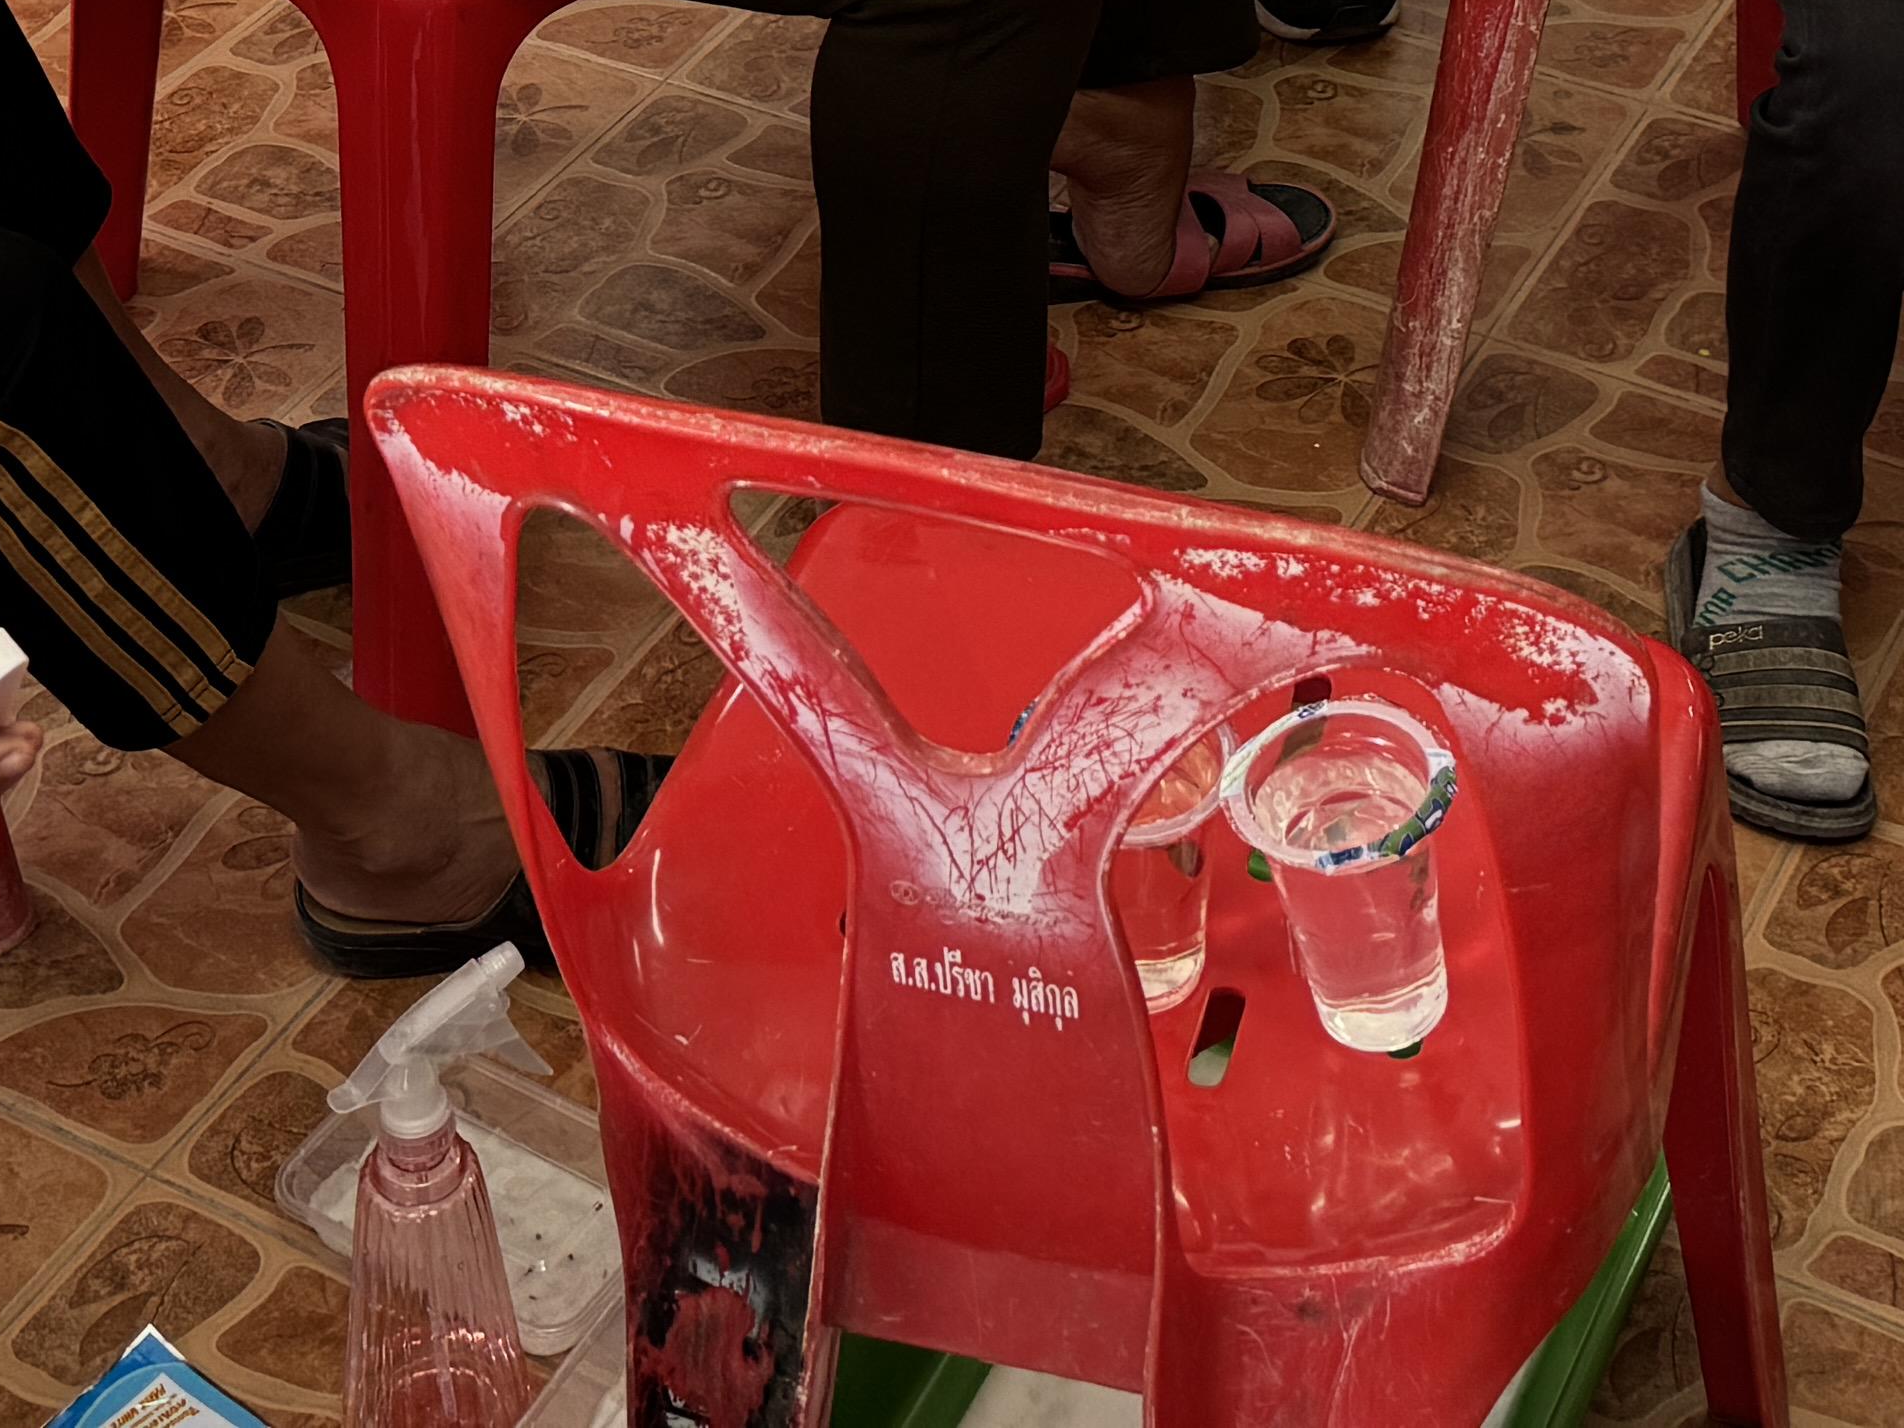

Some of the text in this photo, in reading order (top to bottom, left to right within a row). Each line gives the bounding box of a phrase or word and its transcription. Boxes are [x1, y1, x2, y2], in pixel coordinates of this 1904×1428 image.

[890, 947, 1079, 1031] ส.ส.ปรีชา มุสิกุล
